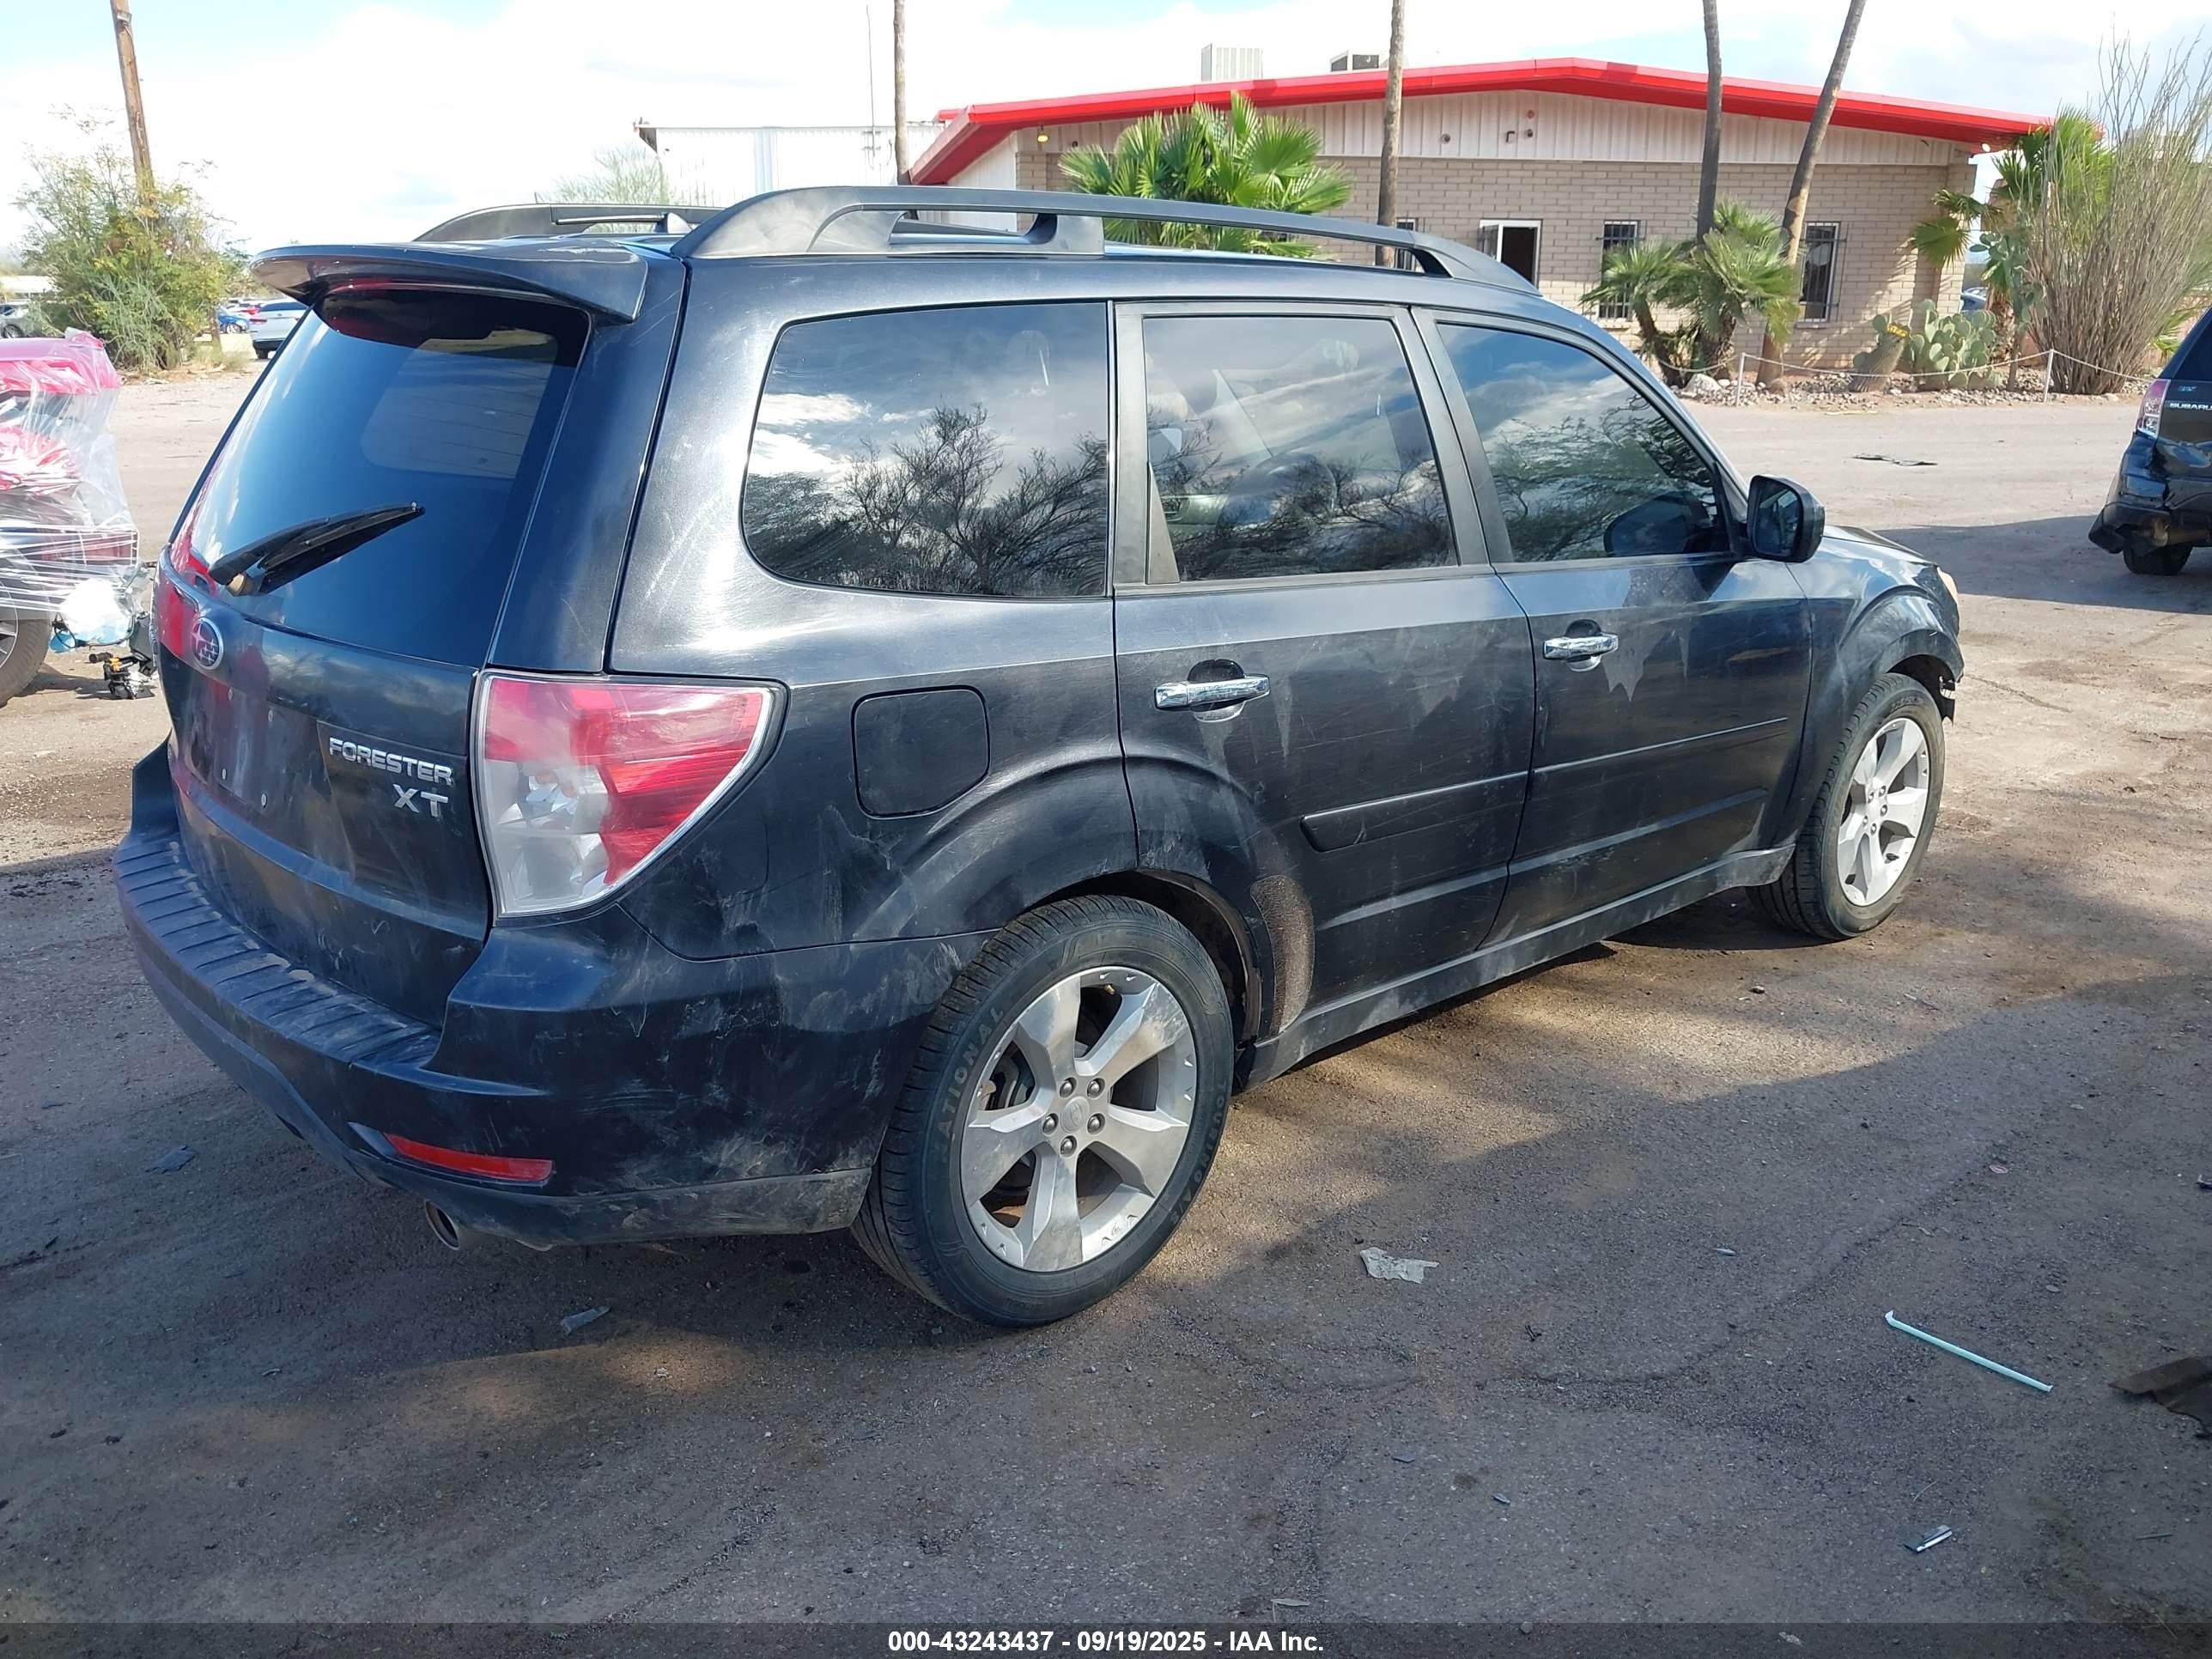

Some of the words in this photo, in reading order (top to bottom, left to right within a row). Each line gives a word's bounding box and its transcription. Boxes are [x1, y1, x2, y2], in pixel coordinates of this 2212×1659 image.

[2169, 402, 2212, 410] SUBARU
[329, 737, 454, 786] FORESTER
[392, 783, 449, 817] XT
